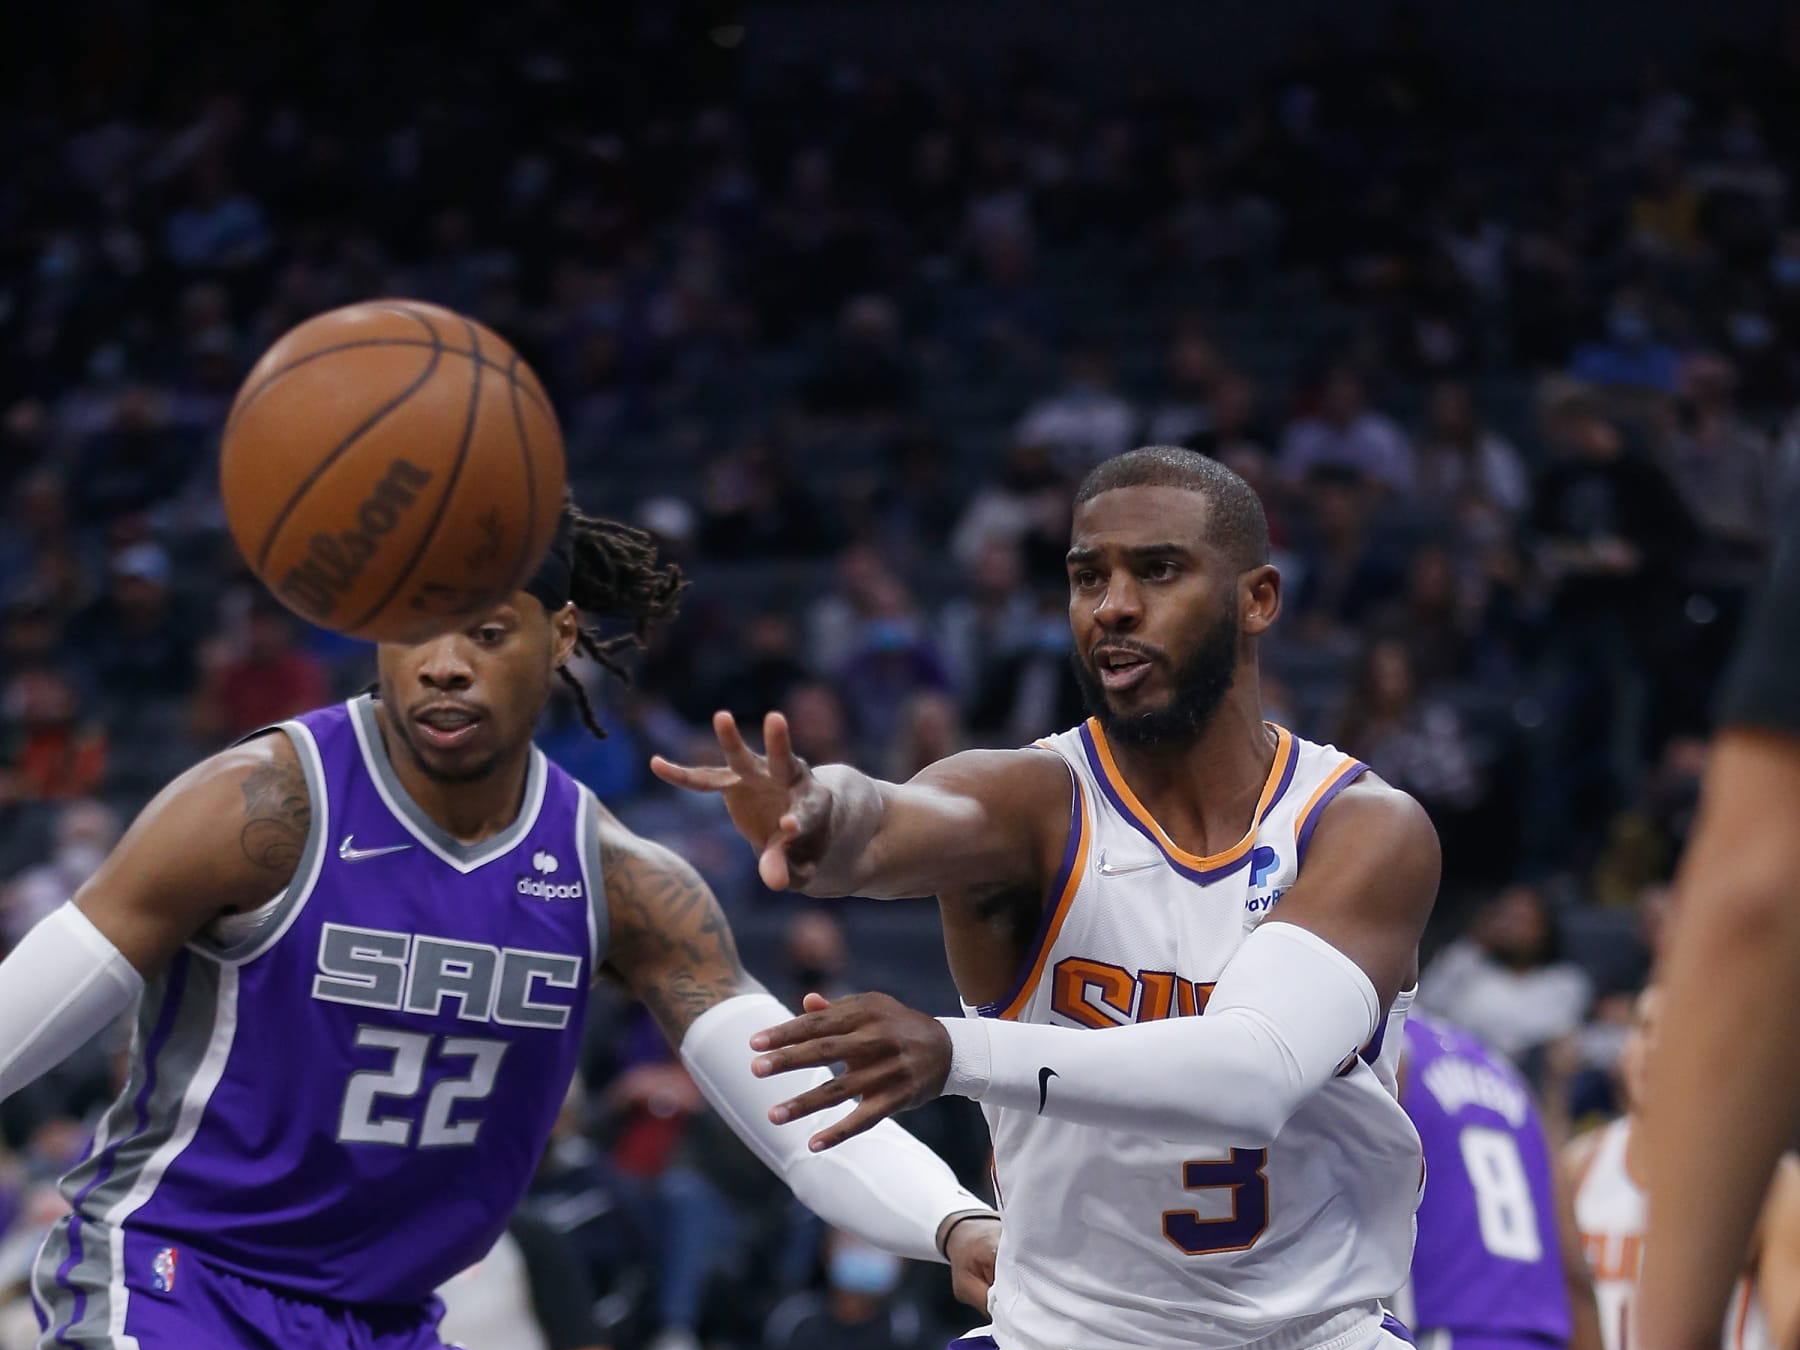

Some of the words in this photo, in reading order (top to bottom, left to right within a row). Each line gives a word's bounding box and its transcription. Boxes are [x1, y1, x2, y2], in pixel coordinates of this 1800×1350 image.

[517, 878, 583, 902] dialpad
[311, 922, 582, 1030] SAC
[336, 1024, 511, 1148] 22
[1162, 1147, 1269, 1256] 3
[1459, 1125, 1543, 1264] 8
